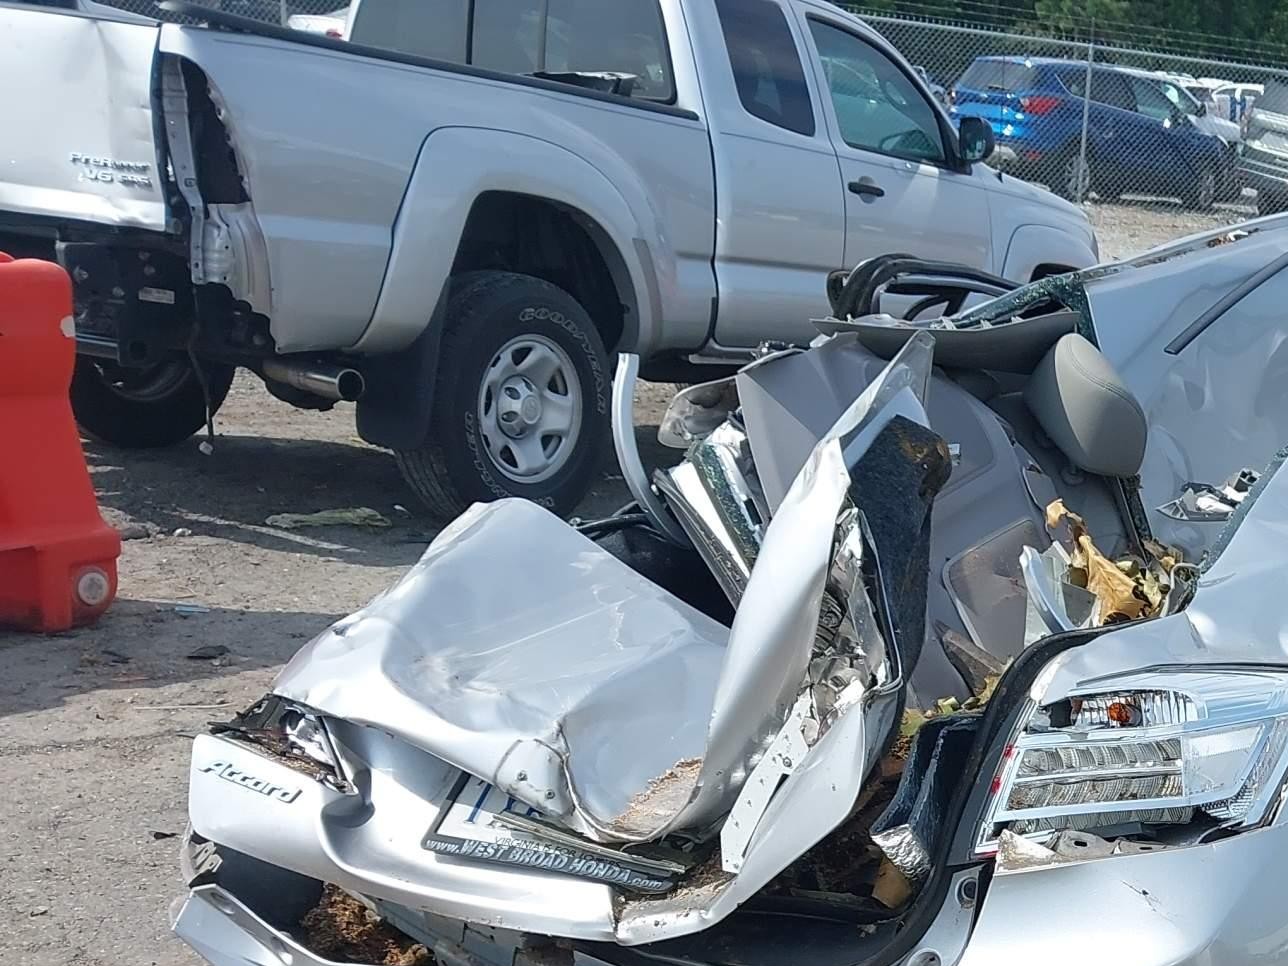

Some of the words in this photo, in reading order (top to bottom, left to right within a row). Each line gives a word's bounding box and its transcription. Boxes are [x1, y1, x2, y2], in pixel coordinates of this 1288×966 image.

[520, 307, 607, 415] GOODYEAR
[197, 759, 303, 804] Accord
[425, 839, 509, 860] www.WEST
[508, 846, 568, 870] BROAD
[569, 857, 663, 890] HONDA.com
[494, 835, 540, 850] VIRGINIA
[555, 846, 577, 858] FOR
